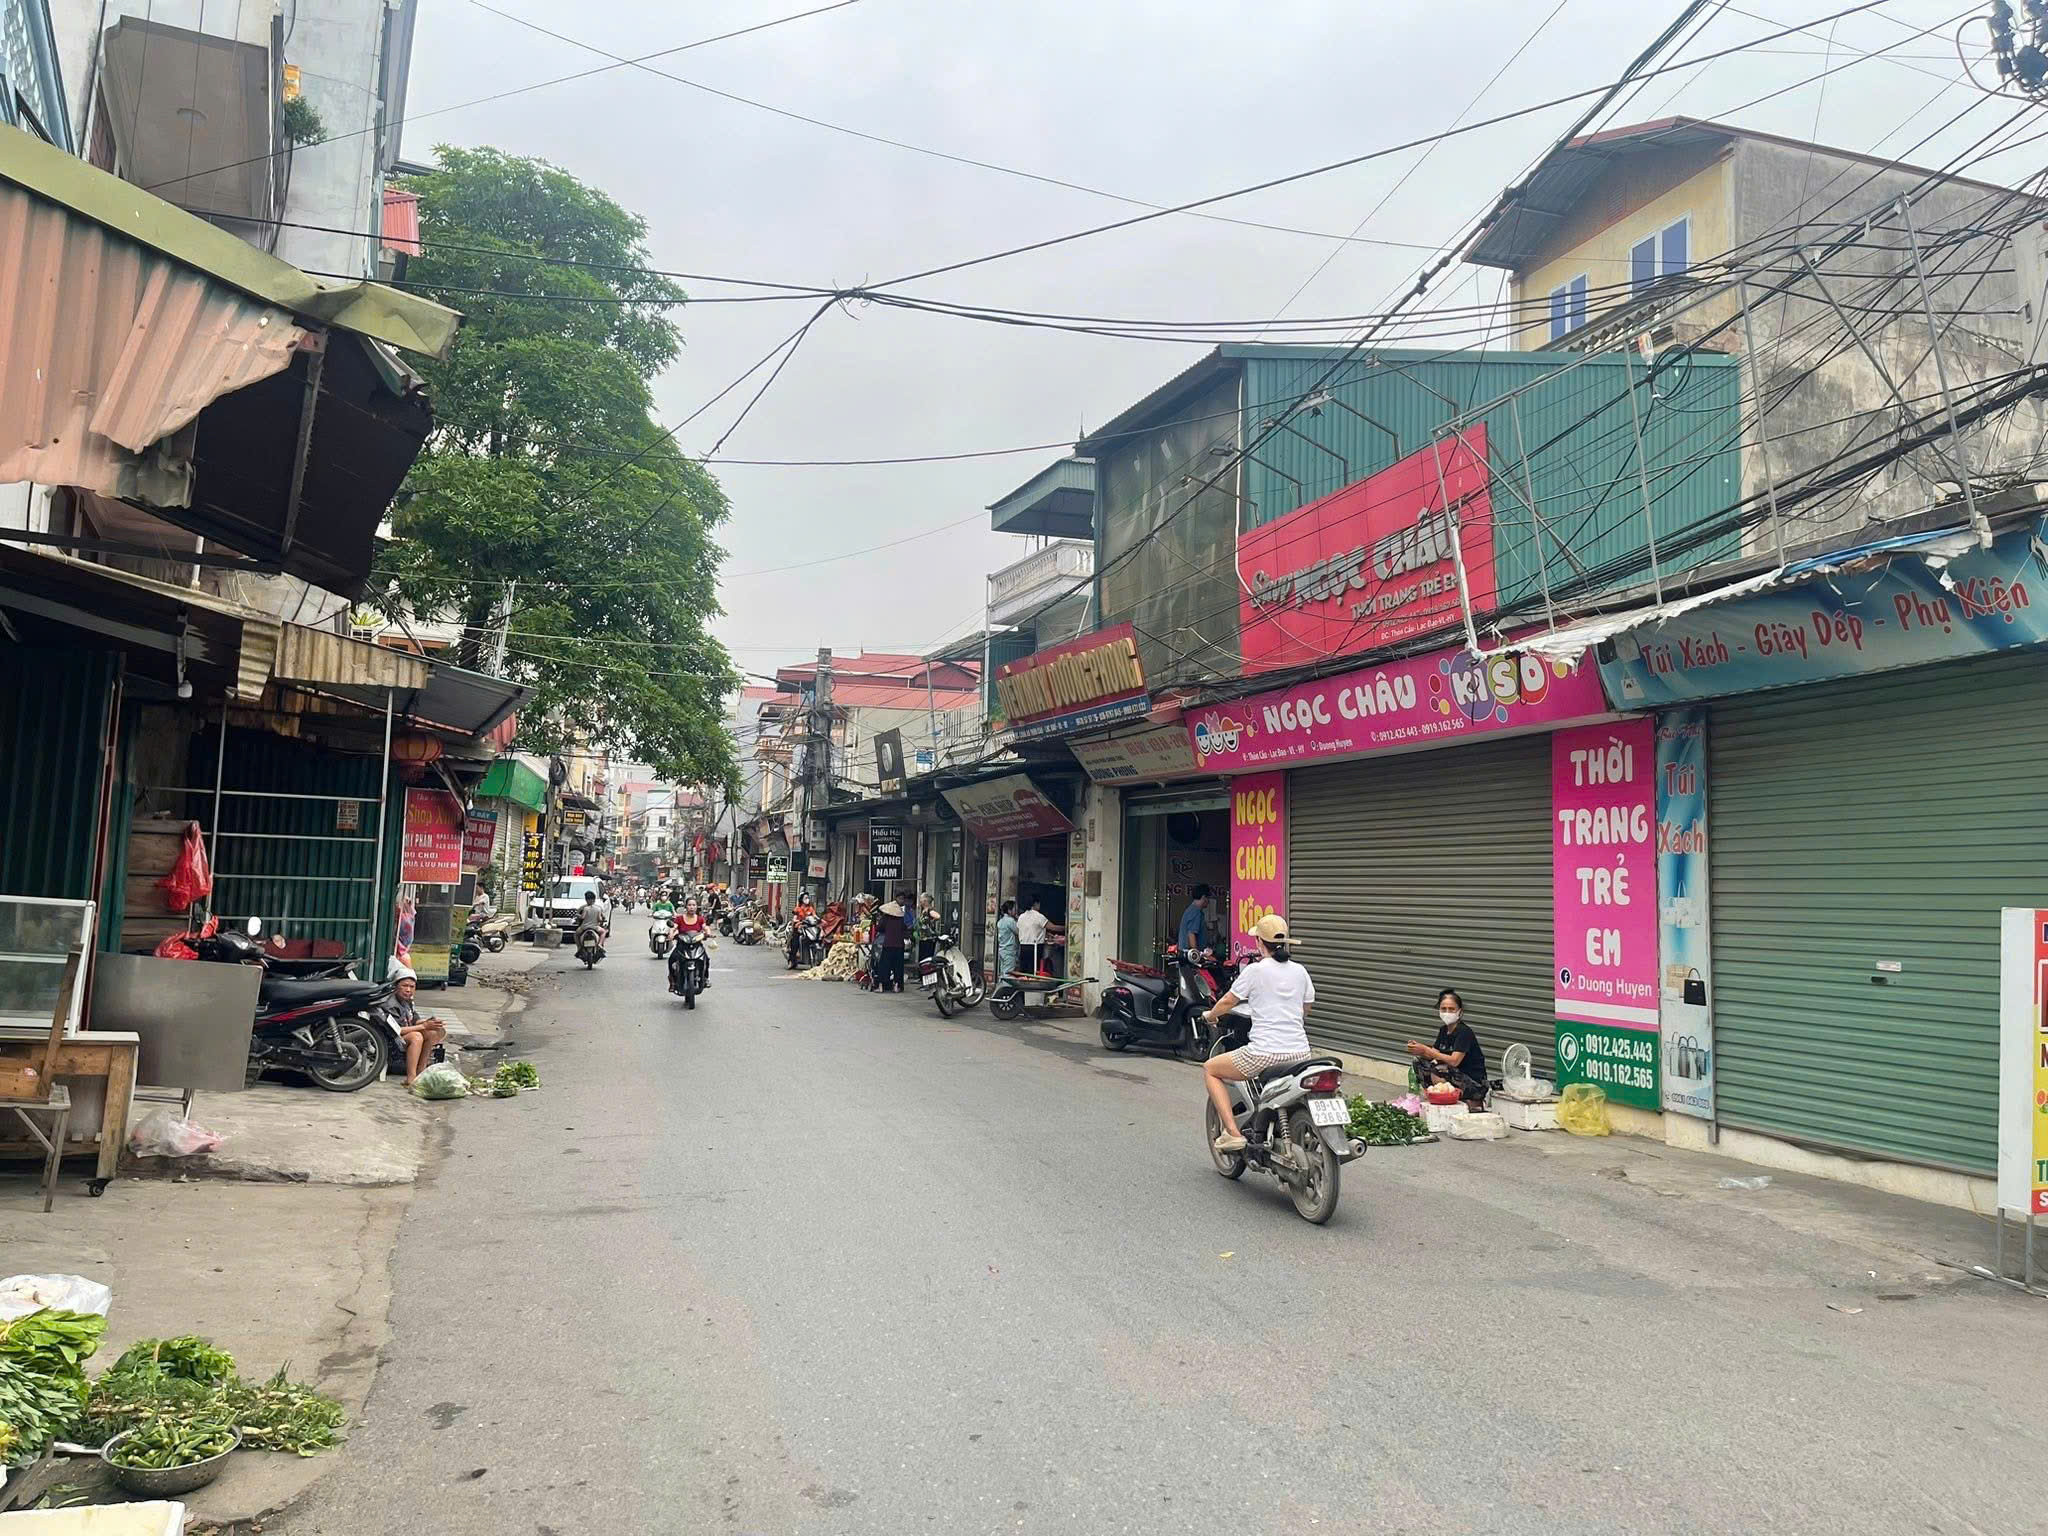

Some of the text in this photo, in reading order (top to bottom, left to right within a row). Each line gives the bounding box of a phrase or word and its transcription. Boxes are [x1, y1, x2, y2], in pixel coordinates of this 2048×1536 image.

[1296, 546, 1368, 608] NGỌC
[1378, 584, 1418, 614] TRANG
[1419, 571, 1442, 599] TRẺ
[1641, 644, 1675, 676] Túi
[1678, 630, 1729, 669] Xách
[1755, 622, 1807, 659] Giày
[1811, 609, 1863, 650] Dép
[1893, 590, 1952, 634] Phụ
[1953, 575, 2031, 624] Kiện
[1263, 694, 1331, 735] NGỌC
[1338, 671, 1417, 720] CHÂU
[1570, 737, 1634, 786] THỜI
[1665, 762, 1696, 797] Túi
[1235, 787, 1277, 833] NGỌC
[1559, 804, 1648, 845] TRANG
[877, 841, 897, 854] THỜI
[1658, 821, 1706, 855] Xách
[872, 856, 902, 867] TRANG
[876, 868, 897, 878] NAM
[1235, 835, 1277, 881] CHÂU
[1576, 853, 1630, 906] TRẺ
[1585, 928, 1621, 966] EM
[1578, 975, 1653, 999] Duong Huyen
[1586, 1033, 1653, 1063] 0912.425.443
[1586, 1059, 1653, 1089] 0919.162.565
